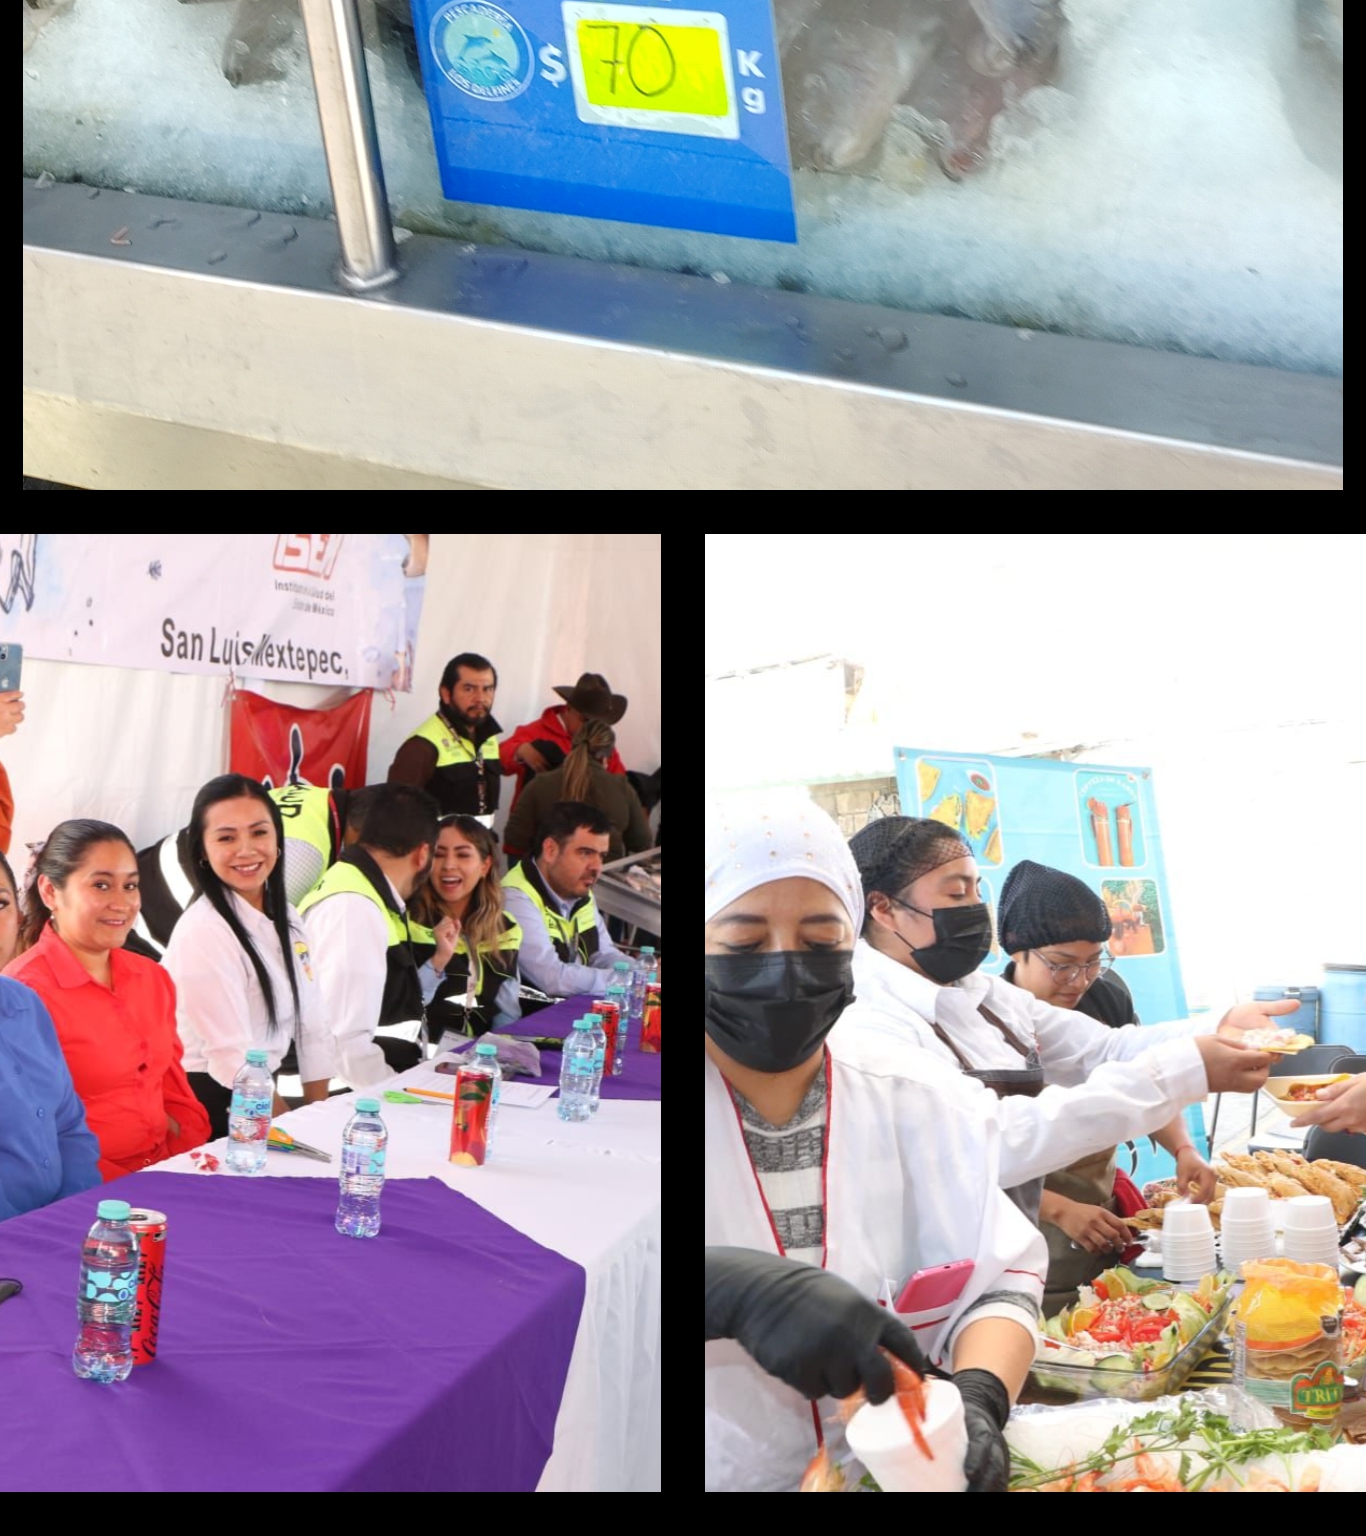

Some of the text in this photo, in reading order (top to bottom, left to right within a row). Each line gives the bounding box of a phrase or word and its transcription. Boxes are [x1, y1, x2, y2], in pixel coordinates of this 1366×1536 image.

[538, 24, 766, 98] $ 70 K
[742, 86, 766, 115] g
[160, 618, 203, 662] San
[210, 626, 254, 666] Luis
